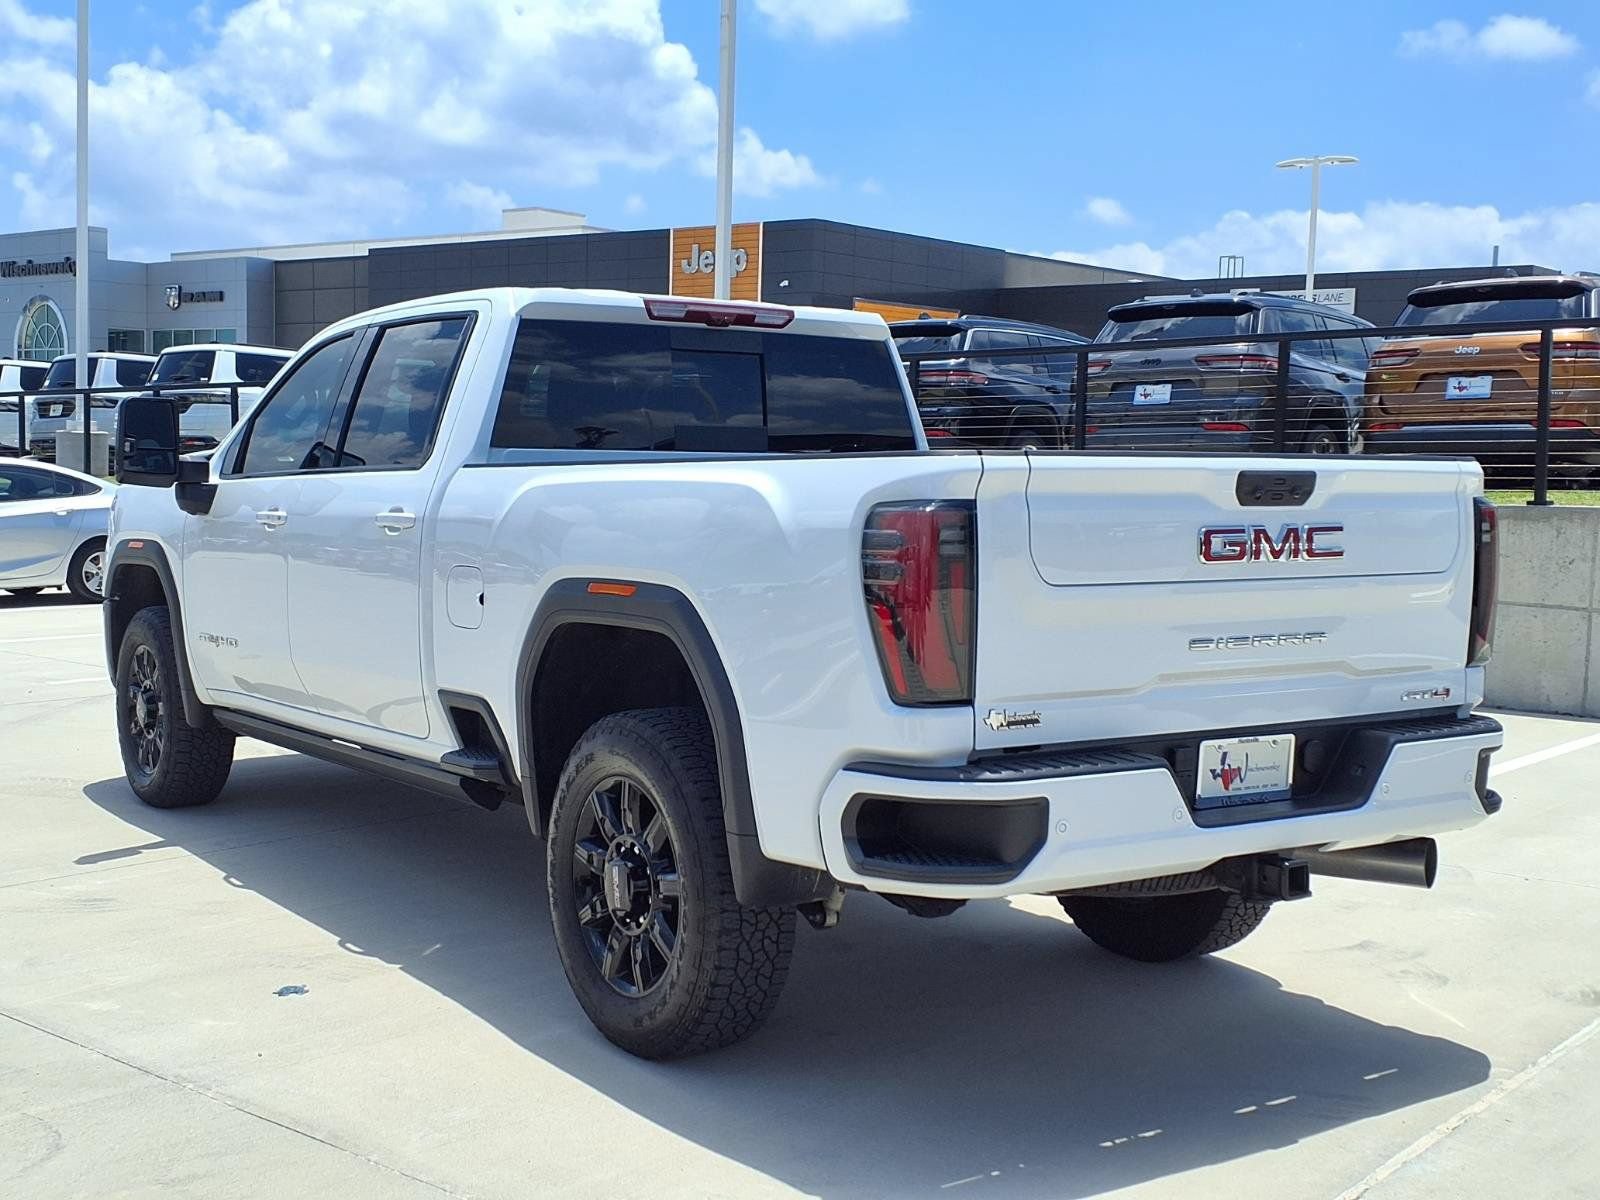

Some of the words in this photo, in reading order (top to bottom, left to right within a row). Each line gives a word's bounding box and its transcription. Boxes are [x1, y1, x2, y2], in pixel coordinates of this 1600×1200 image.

[681, 244, 748, 278] Jep
[182, 291, 224, 303] RAM
[1317, 293, 1345, 303] LANE
[1455, 346, 1480, 355] Jeep
[1198, 522, 1345, 565] GMC
[1189, 631, 1328, 651] SIERRA
[1400, 687, 1450, 701] AT4
